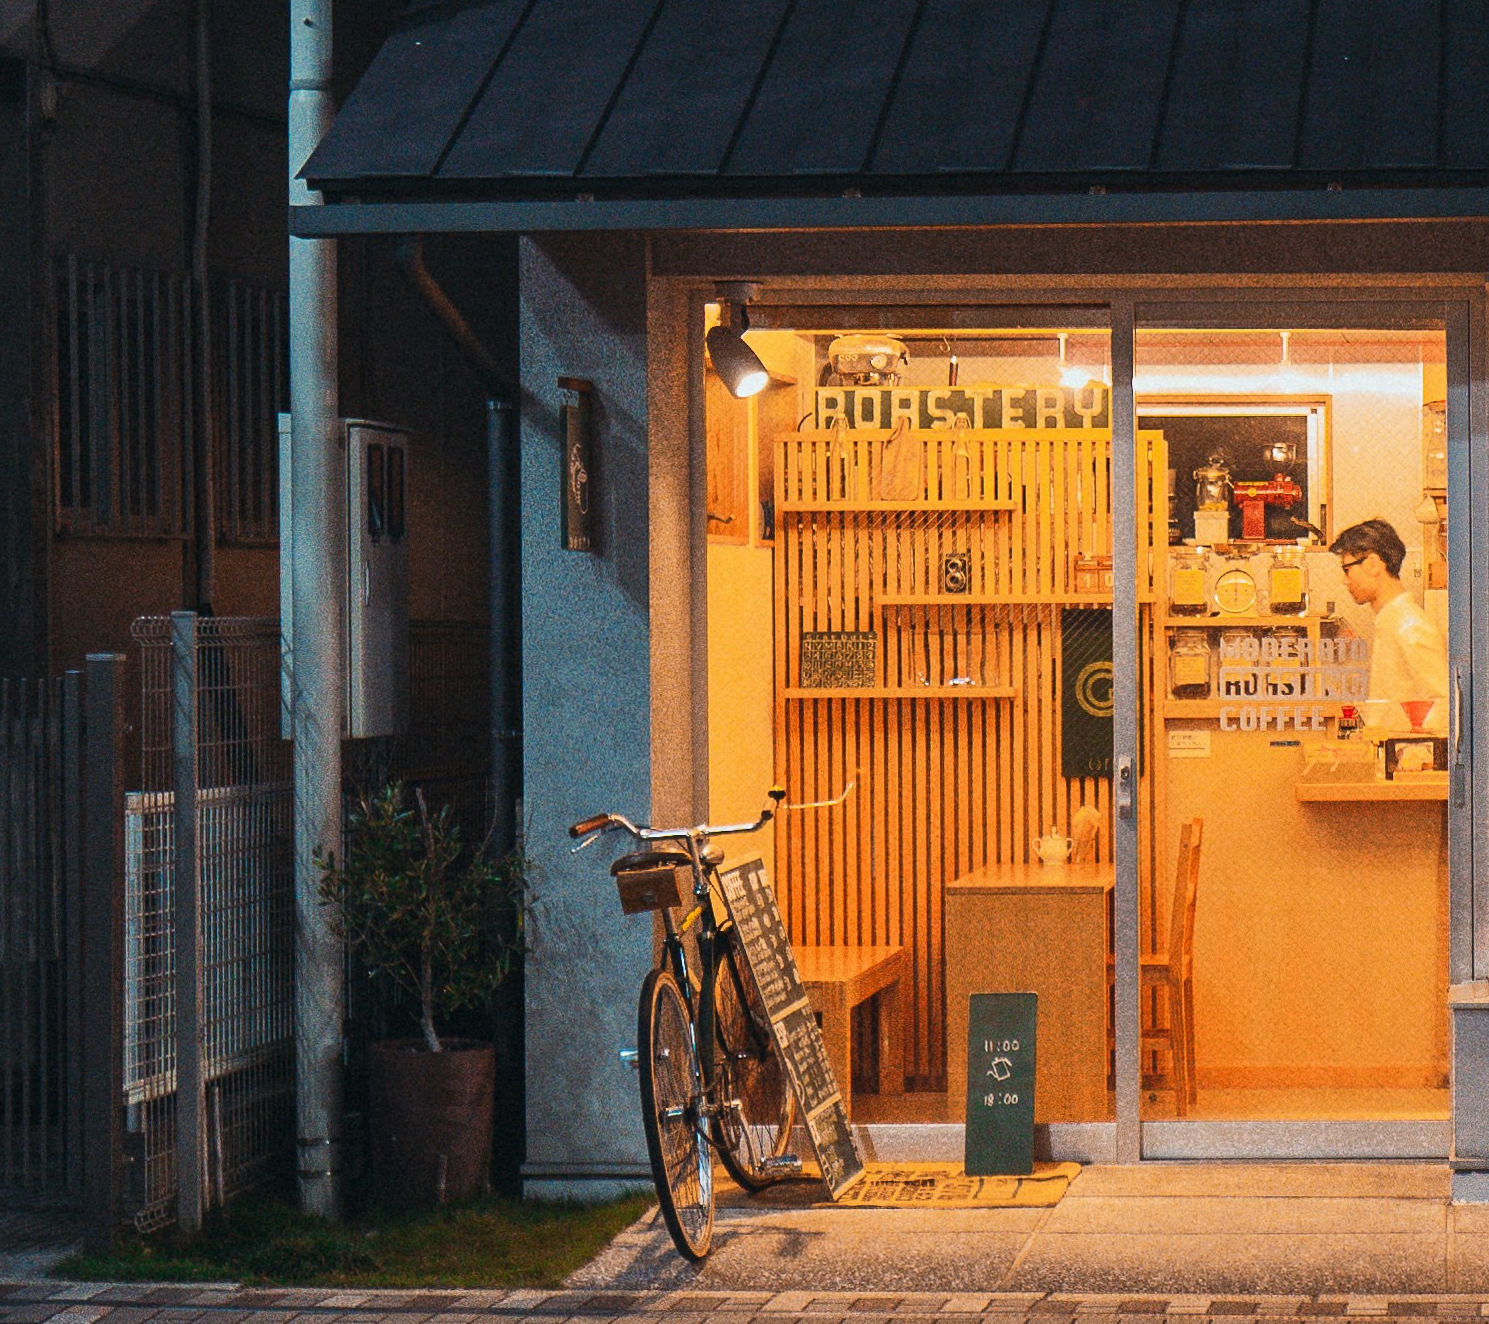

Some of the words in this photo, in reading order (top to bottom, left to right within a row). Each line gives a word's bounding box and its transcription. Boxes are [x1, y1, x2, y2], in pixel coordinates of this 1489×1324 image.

[818, 388, 1103, 429] ROASTERY
[1219, 636, 1368, 661] MODERATO
[1224, 672, 1366, 697] ROASTING
[1219, 706, 1327, 732] COFFEE
[984, 1039, 1020, 1052] 11:00
[984, 1093, 1019, 1107] 18:00
